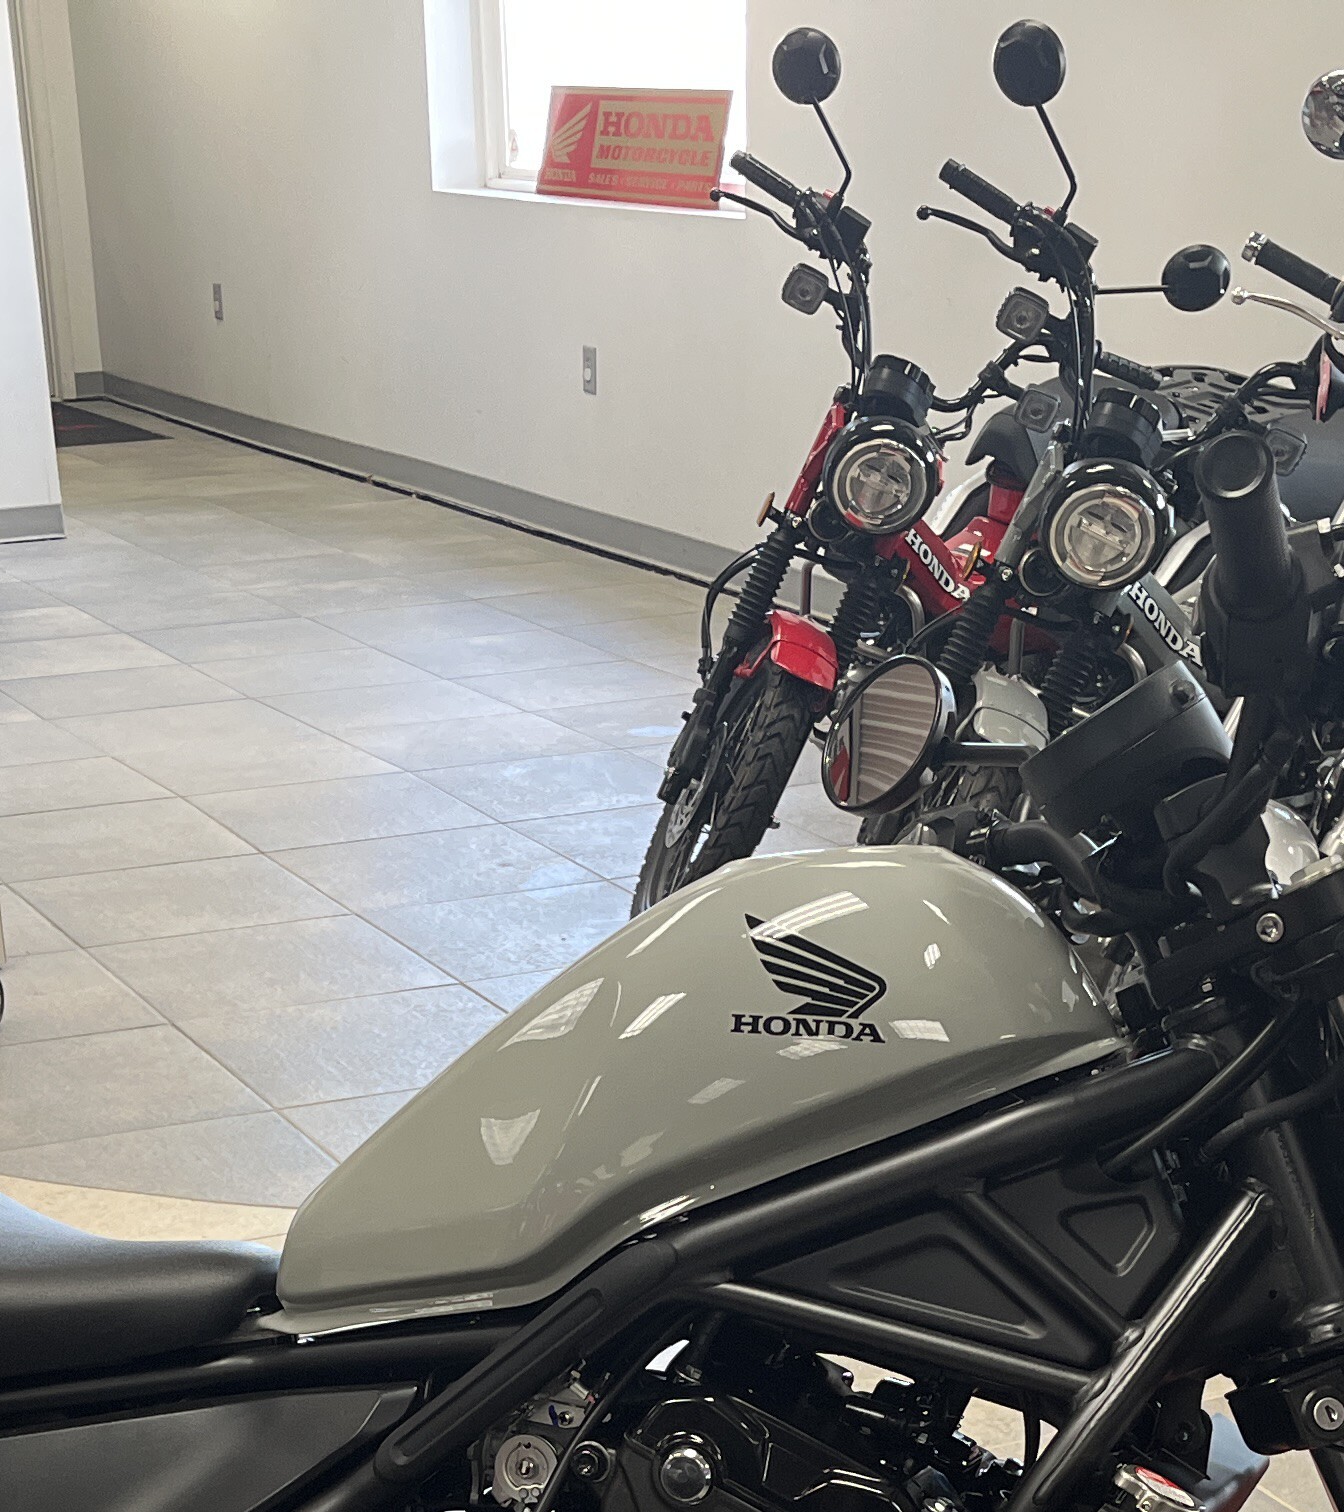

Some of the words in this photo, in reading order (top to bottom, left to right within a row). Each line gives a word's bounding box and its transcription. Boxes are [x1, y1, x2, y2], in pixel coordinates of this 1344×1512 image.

[599, 111, 715, 143] HONDA
[595, 143, 713, 168] MOTORCYCLE
[904, 528, 971, 602] HONDA
[1129, 580, 1204, 668] HONDA
[730, 1013, 886, 1044] HONDA
